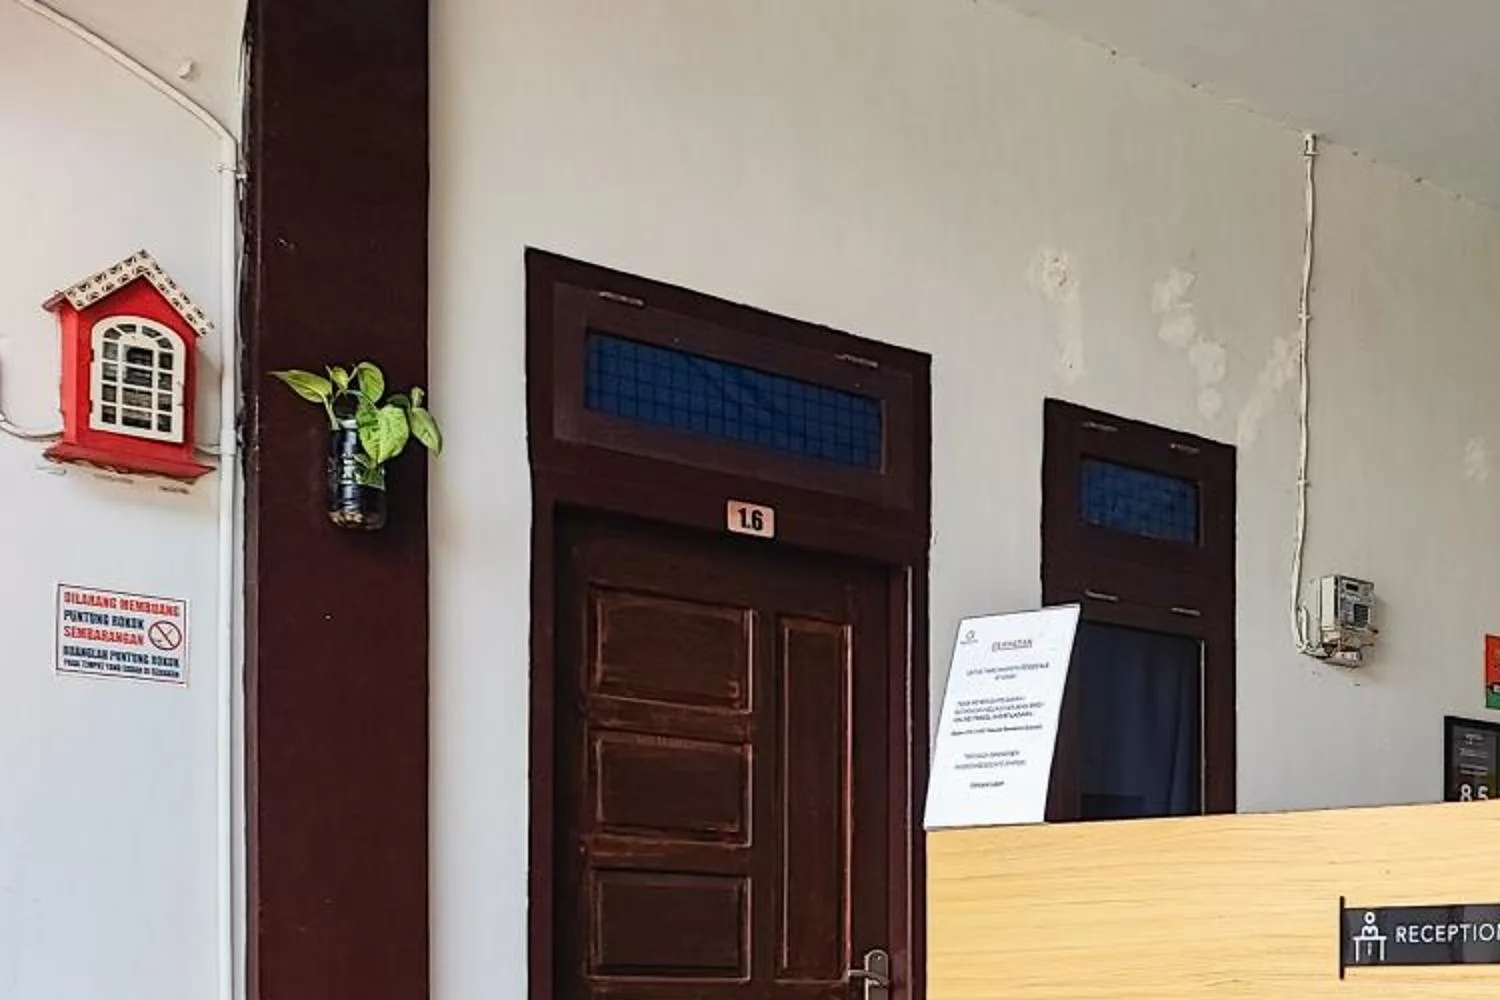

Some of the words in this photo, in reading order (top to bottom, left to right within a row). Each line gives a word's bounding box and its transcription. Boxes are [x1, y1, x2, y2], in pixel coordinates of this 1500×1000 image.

[737, 507, 764, 531] 16
[64, 591, 117, 609] DILARANG
[63, 609, 109, 626] PUNTUNG
[111, 615, 145, 630] ROKOK
[63, 626, 145, 646] SEMBARANGAN
